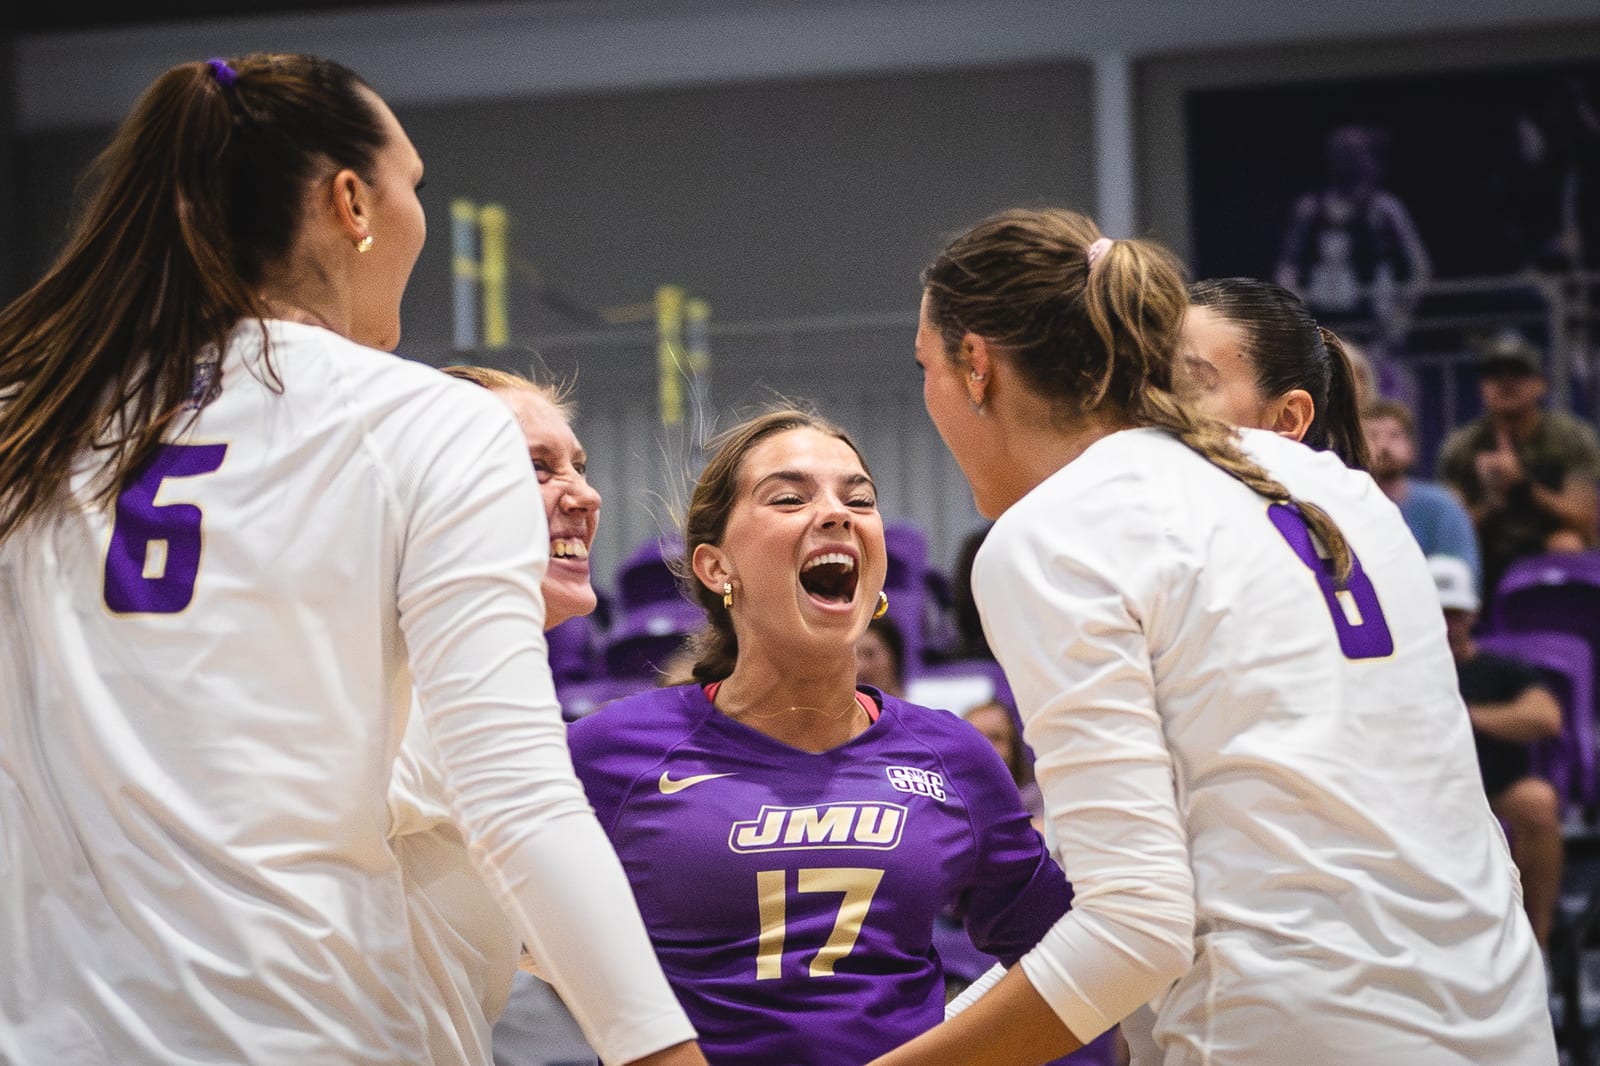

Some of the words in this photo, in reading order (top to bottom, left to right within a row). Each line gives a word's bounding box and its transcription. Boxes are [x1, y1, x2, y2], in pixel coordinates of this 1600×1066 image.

[104, 441, 229, 617] 6
[1265, 501, 1396, 662] 8
[736, 806, 901, 847] JMU
[886, 765, 946, 802] SBC
[756, 868, 885, 980] 17
